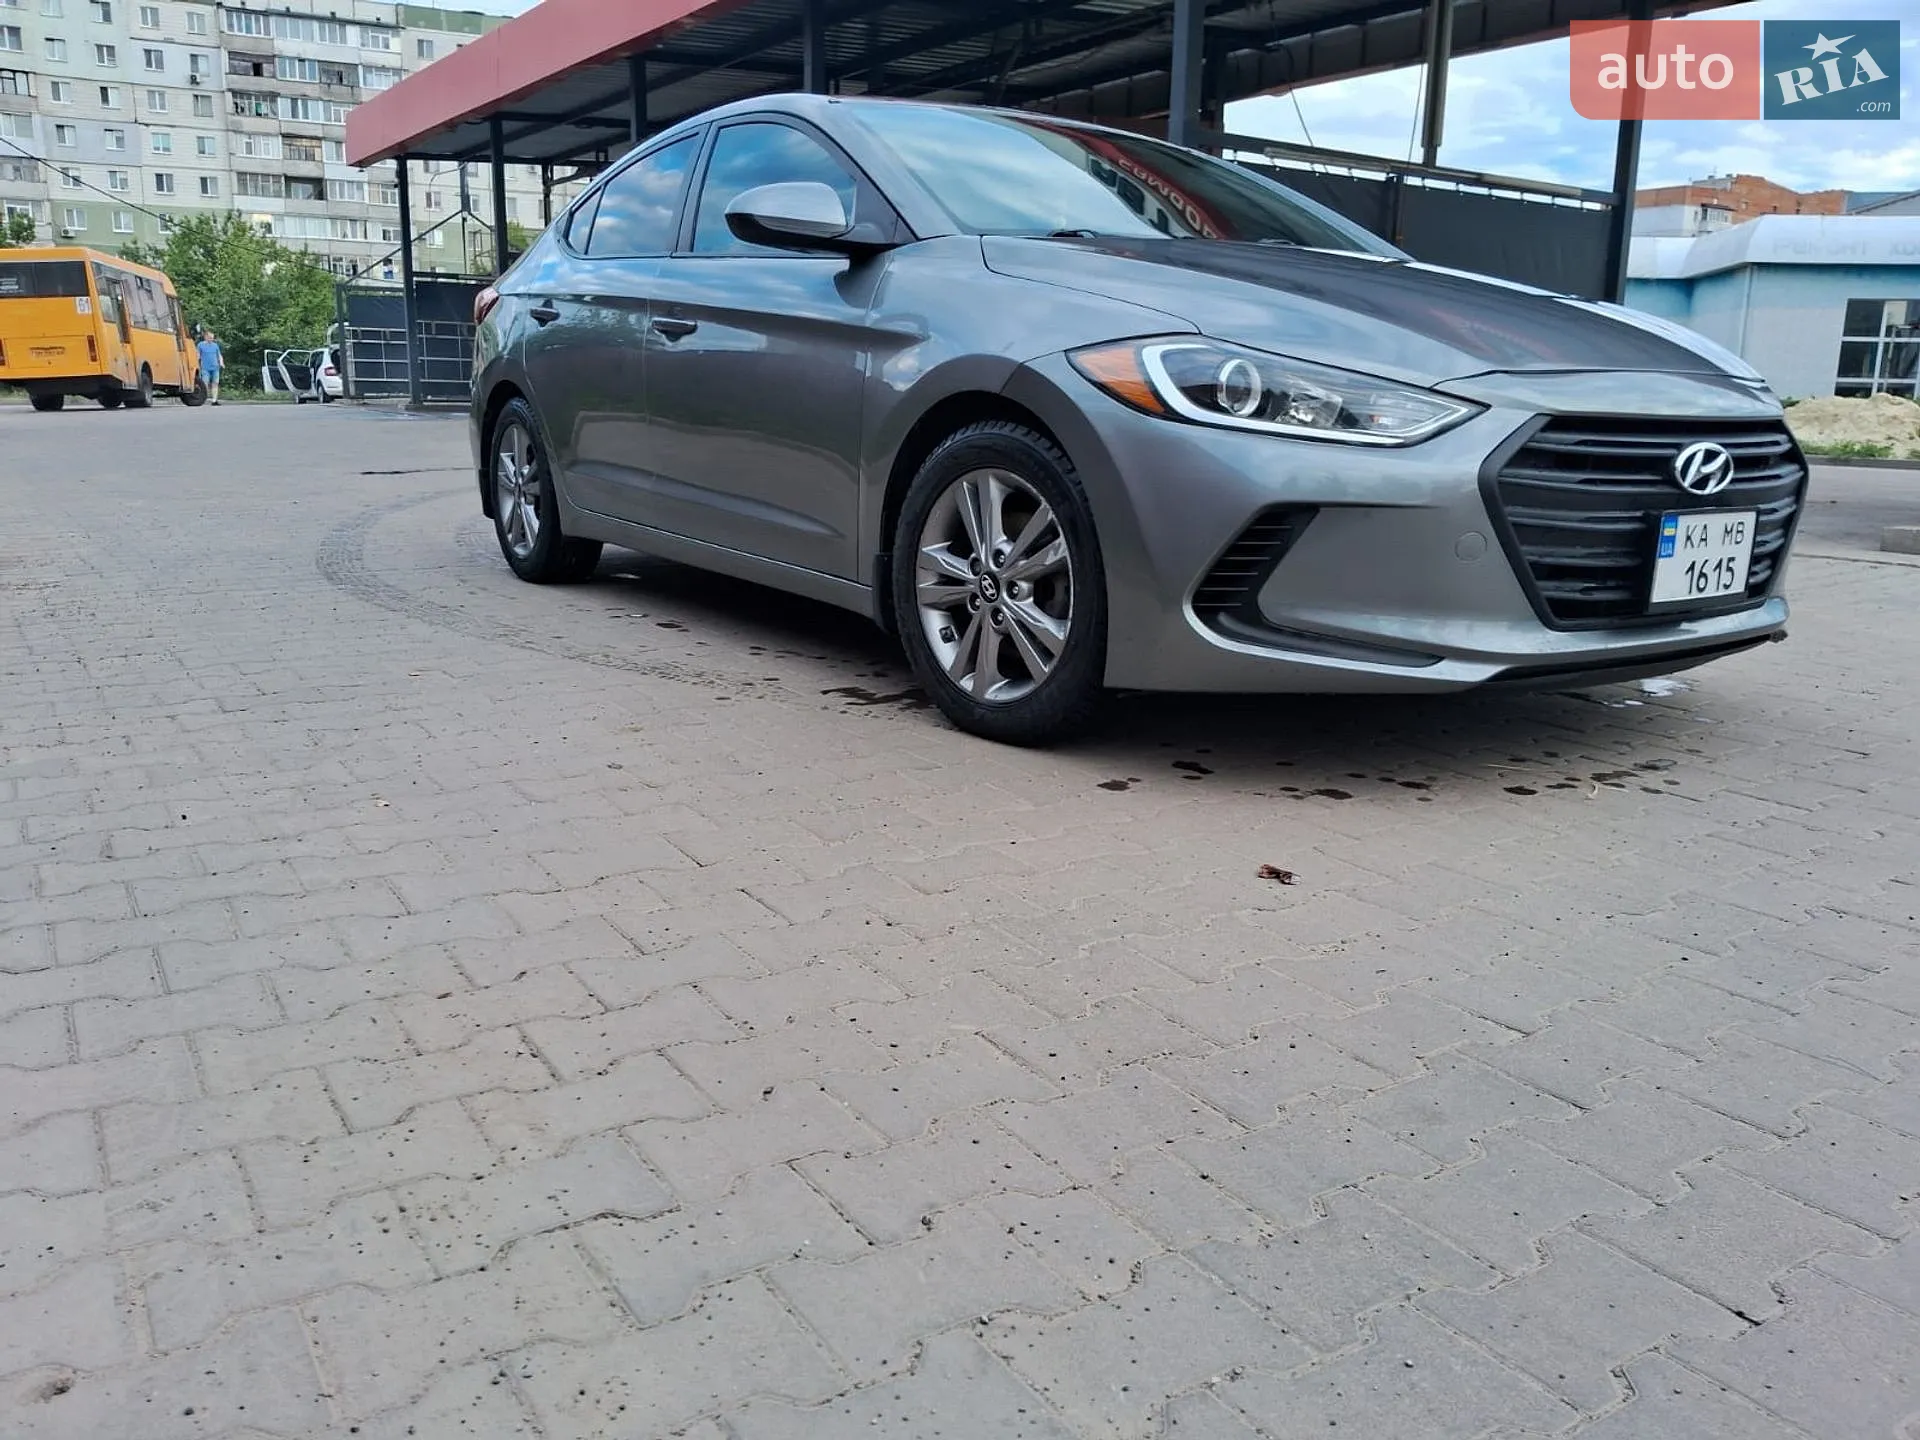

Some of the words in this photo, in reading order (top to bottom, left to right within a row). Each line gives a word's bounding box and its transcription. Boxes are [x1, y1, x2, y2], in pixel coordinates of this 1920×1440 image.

[1683, 522, 1709, 549] KA
[1722, 520, 1745, 545] MB
[1684, 556, 1737, 595] 1615
